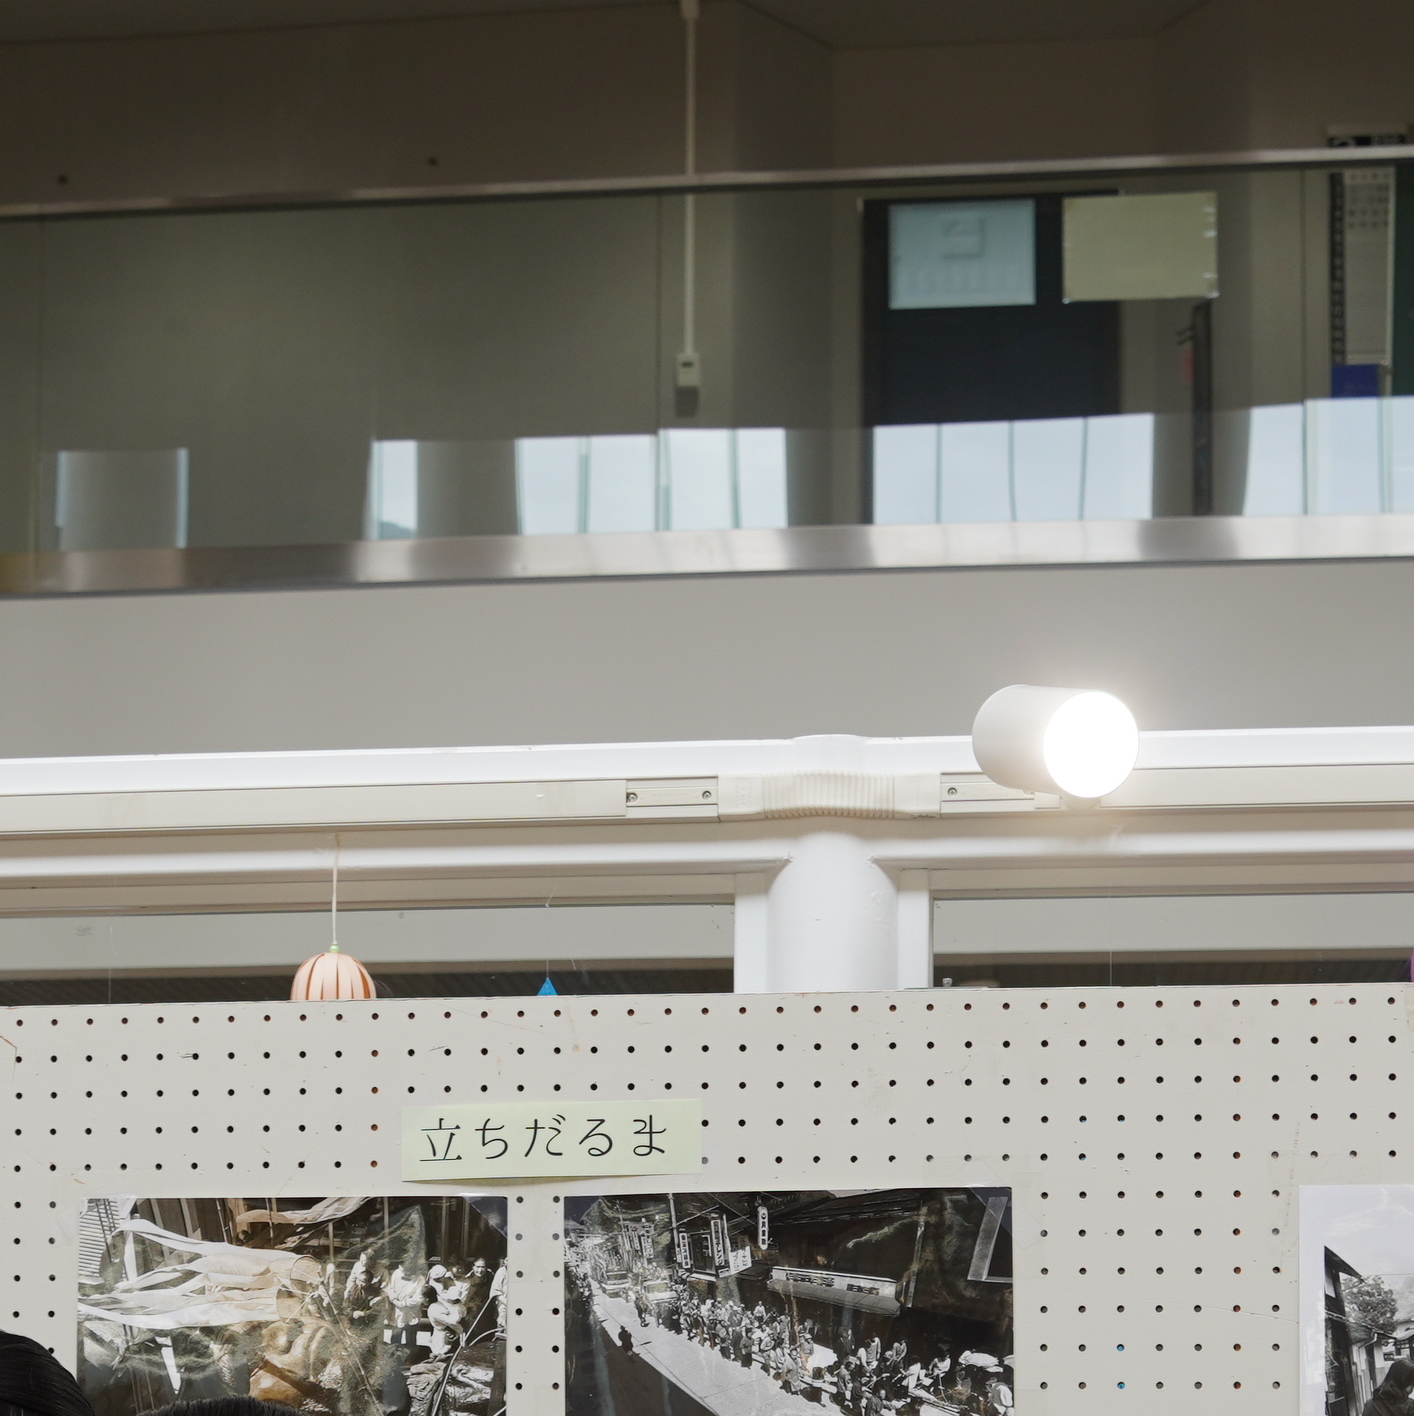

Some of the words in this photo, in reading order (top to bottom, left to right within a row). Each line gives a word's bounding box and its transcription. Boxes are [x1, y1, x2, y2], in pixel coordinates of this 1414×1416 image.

[419, 1114, 667, 1162] 立ちだるま
